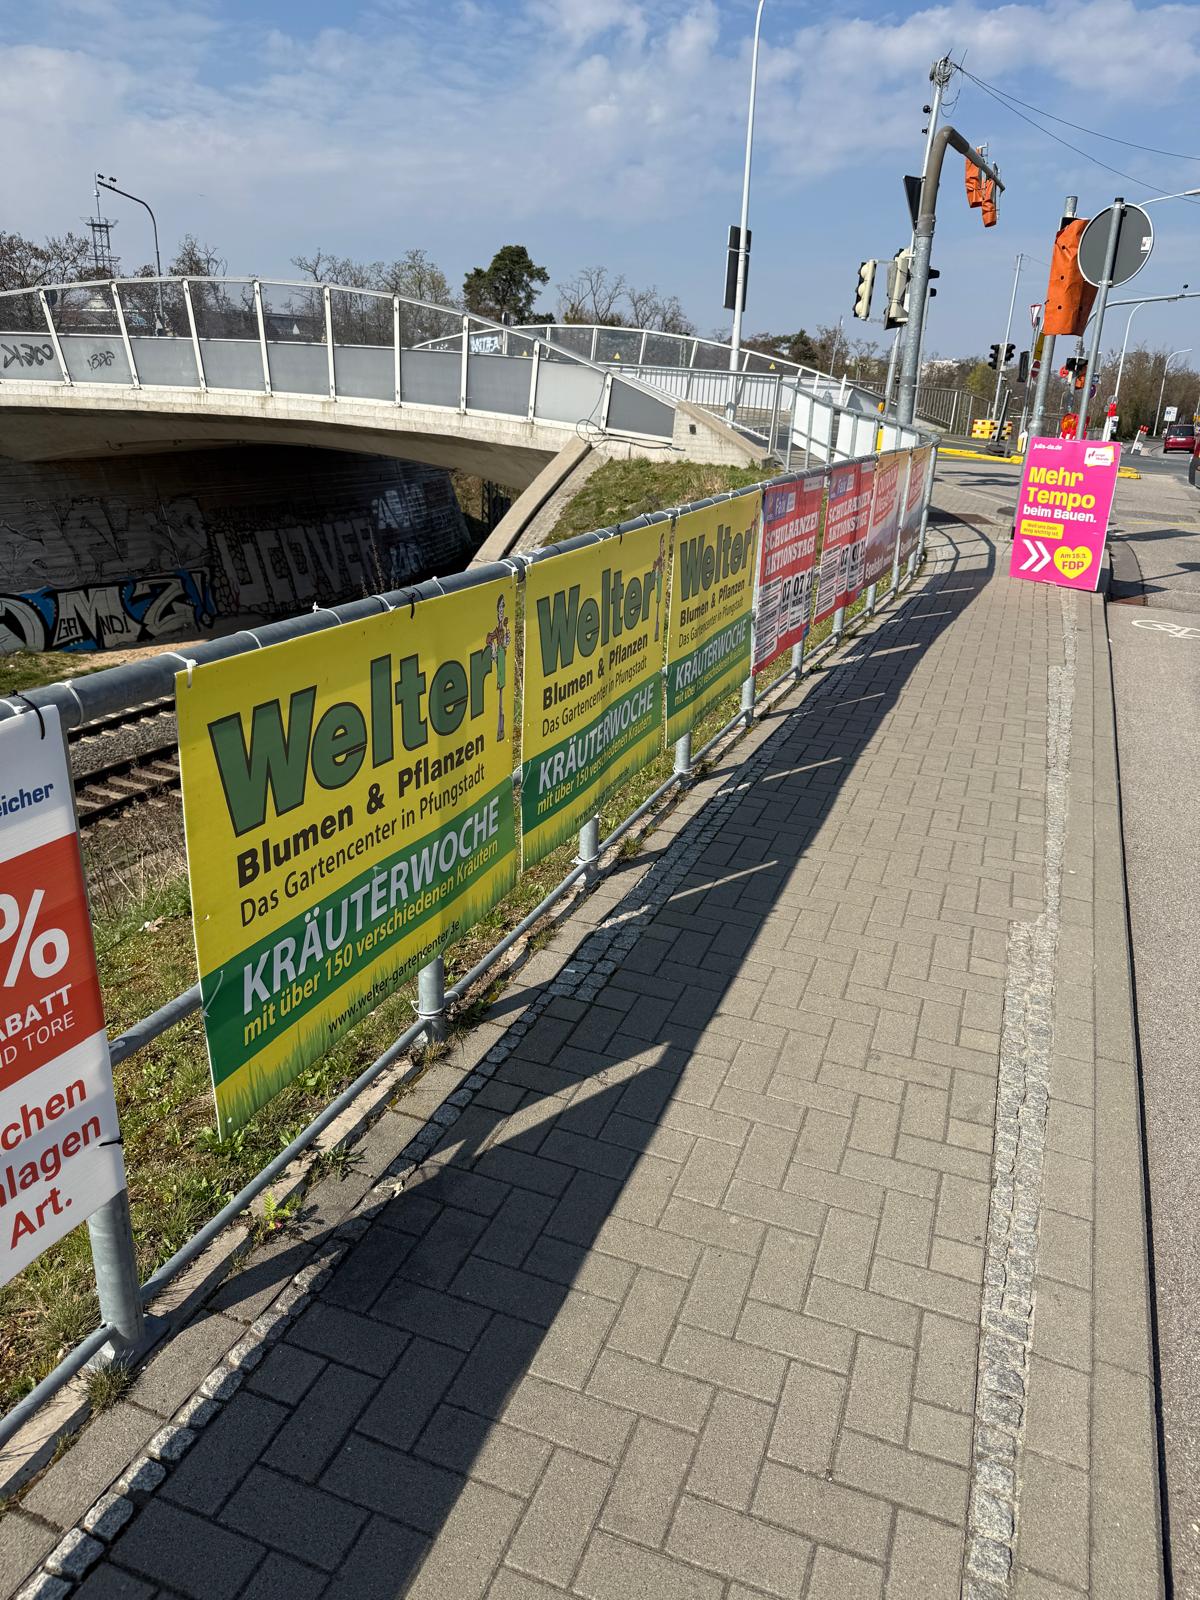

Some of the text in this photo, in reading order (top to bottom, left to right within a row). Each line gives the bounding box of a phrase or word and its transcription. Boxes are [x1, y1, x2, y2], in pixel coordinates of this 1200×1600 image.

[1023, 504, 1097, 523] beim Bauen.
[1026, 487, 1096, 511] Tempo
[1028, 467, 1084, 487] Mehr
[680, 524, 752, 602] Welter
[1062, 560, 1085, 570] FDP
[537, 568, 656, 678] Welter
[679, 633, 689, 648] Das
[680, 579, 745, 628] Blumen & Pflanzen
[542, 633, 648, 711] Blumen & Pflanzen
[675, 618, 747, 692] KRÄUTERWOCHE
[542, 656, 647, 738] Das Gartencenter in Pfungstadt
[207, 649, 493, 838] Welter
[538, 682, 655, 796] KRÄUTERWOCHE
[0, 783, 54, 817] icher
[236, 734, 485, 888] Blumen & Pflanzen
[537, 788, 554, 815] mit
[554, 778, 574, 805] über
[576, 766, 589, 788] 150
[240, 763, 485, 927] Das Gartencenter in Pfungstadt
[243, 796, 499, 1016] KRÄUTERWOCHE
[243, 839, 498, 1047] mit über 150 verschiedenen Kräutern
[328, 920, 460, 1034] www.welter-gartencenter.de
[22, 1010, 75, 1051] TORE
[11, 1187, 73, 1250] Art.
